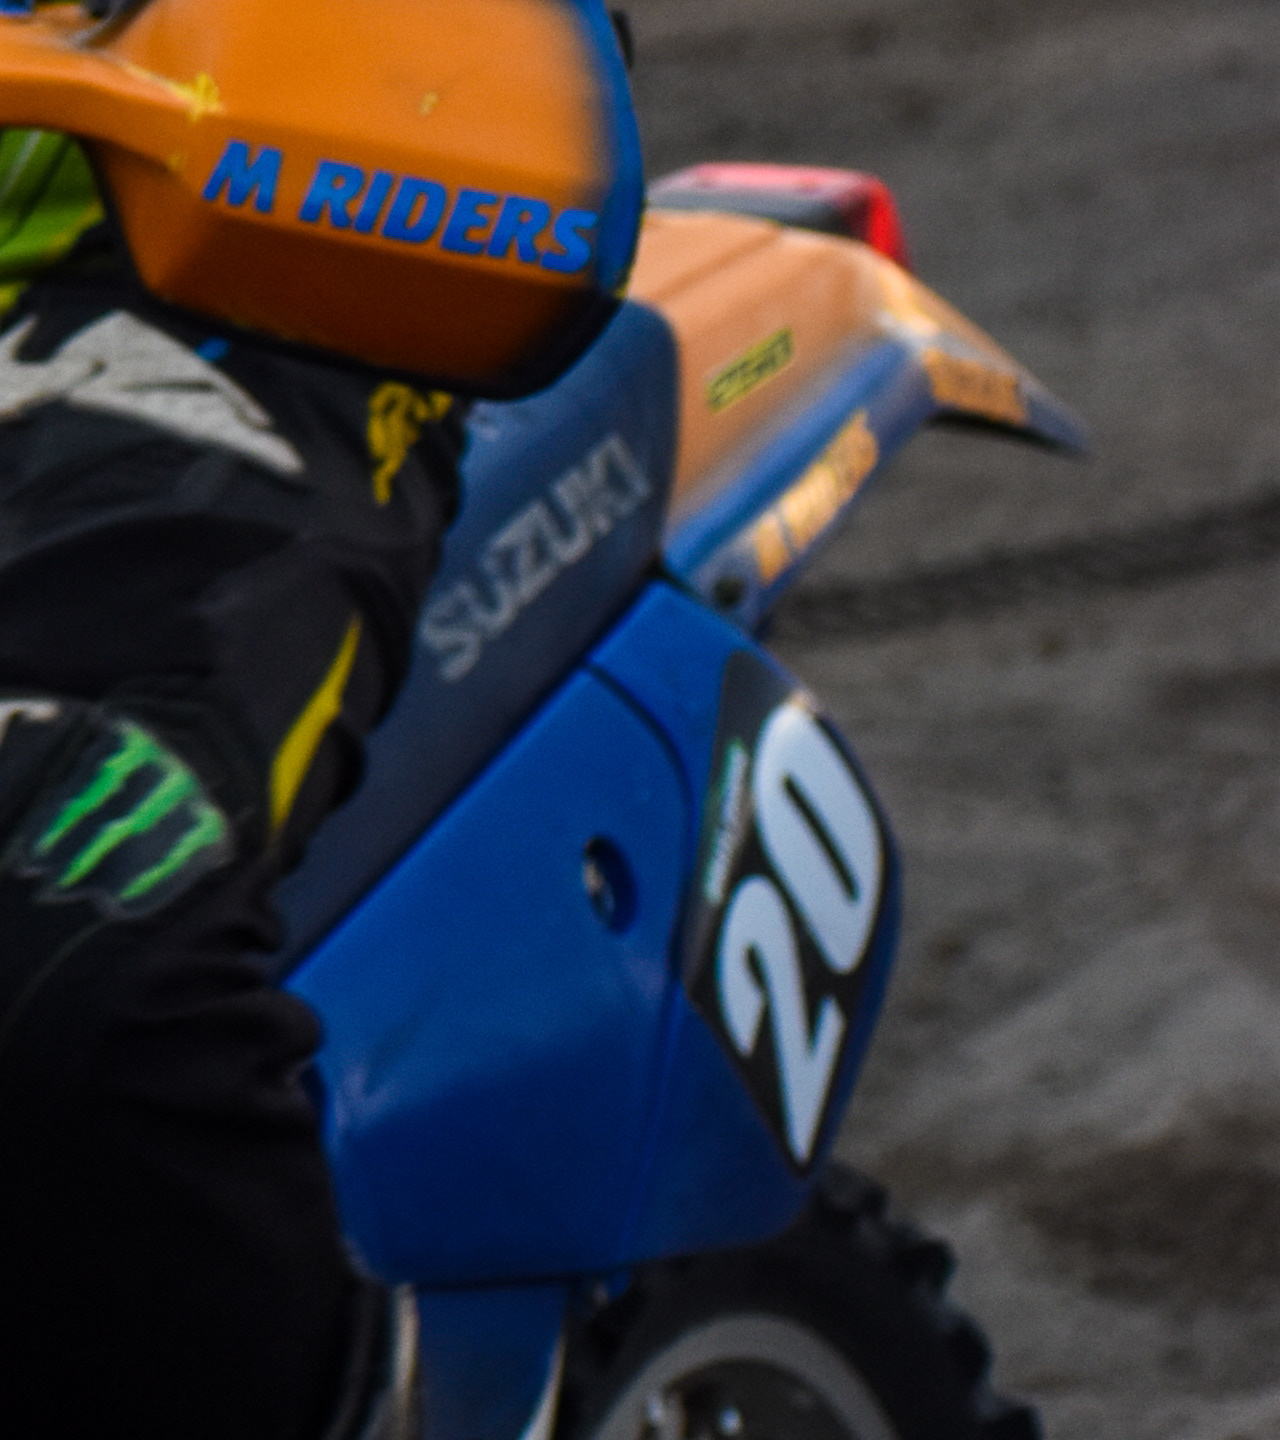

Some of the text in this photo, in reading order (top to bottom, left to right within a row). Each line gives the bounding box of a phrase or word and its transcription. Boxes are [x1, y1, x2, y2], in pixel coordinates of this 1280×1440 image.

[202, 138, 600, 275] M RIDERS
[418, 433, 654, 682] SUZUKI
[716, 700, 887, 1167] 20
